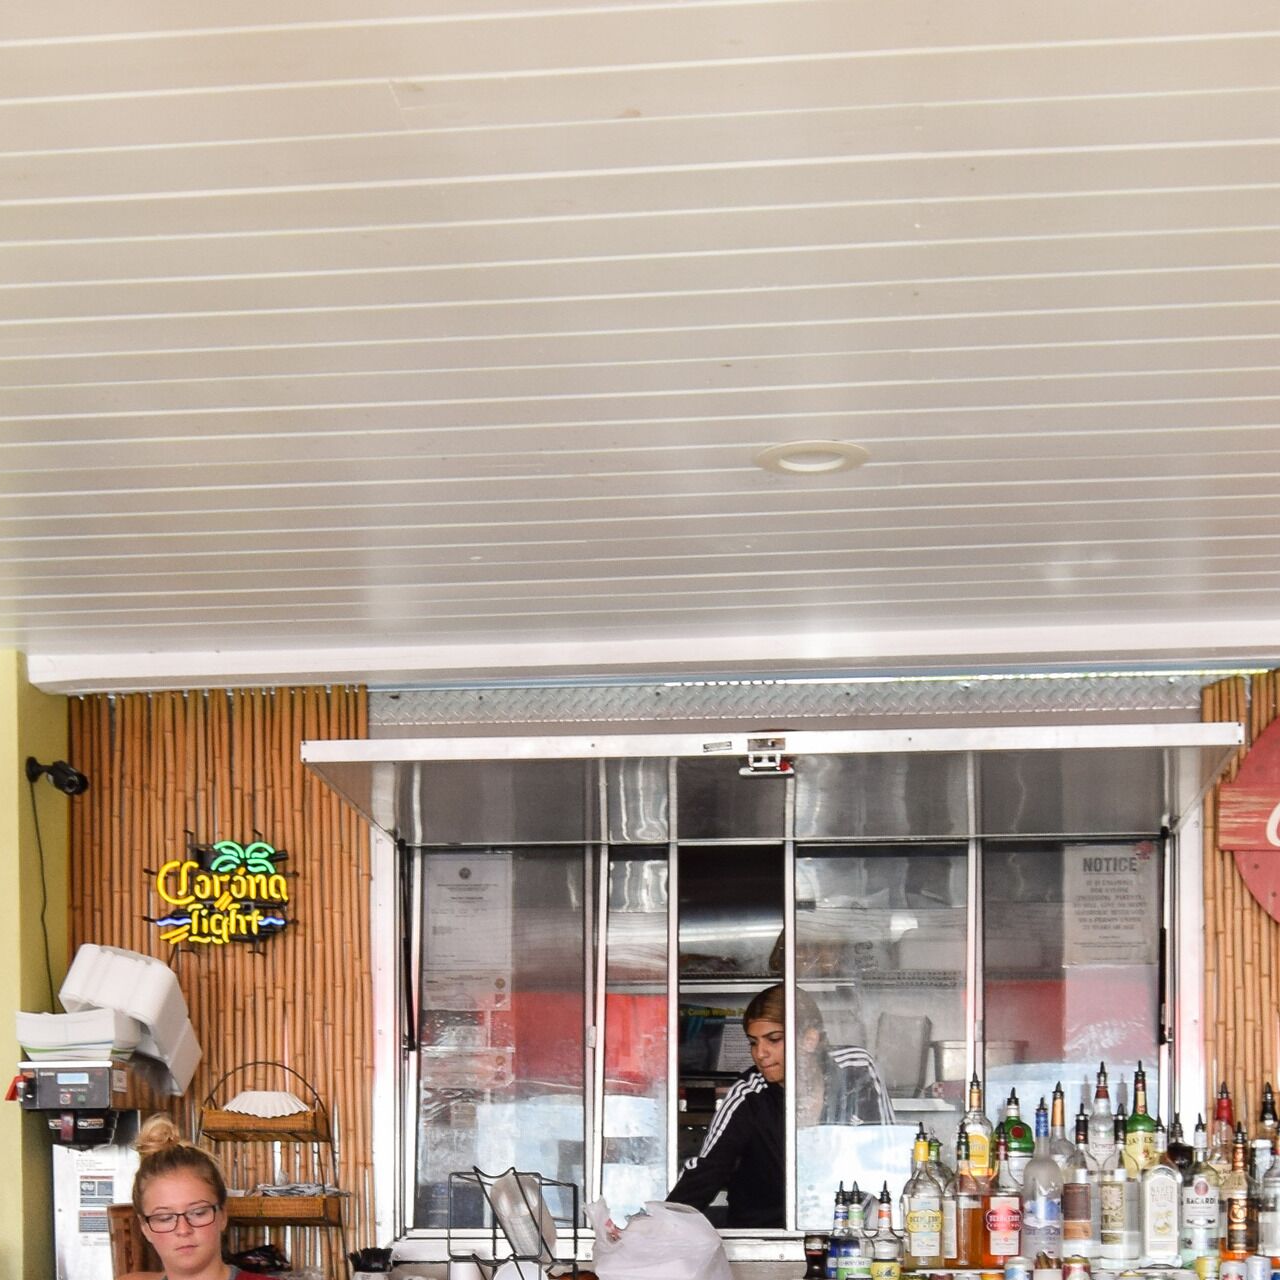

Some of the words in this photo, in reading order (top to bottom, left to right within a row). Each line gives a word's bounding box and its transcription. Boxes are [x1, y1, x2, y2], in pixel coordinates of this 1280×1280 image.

[157, 860, 289, 906] Corona
[1082, 856, 1137, 873] NOTICE
[188, 903, 264, 945] Light
